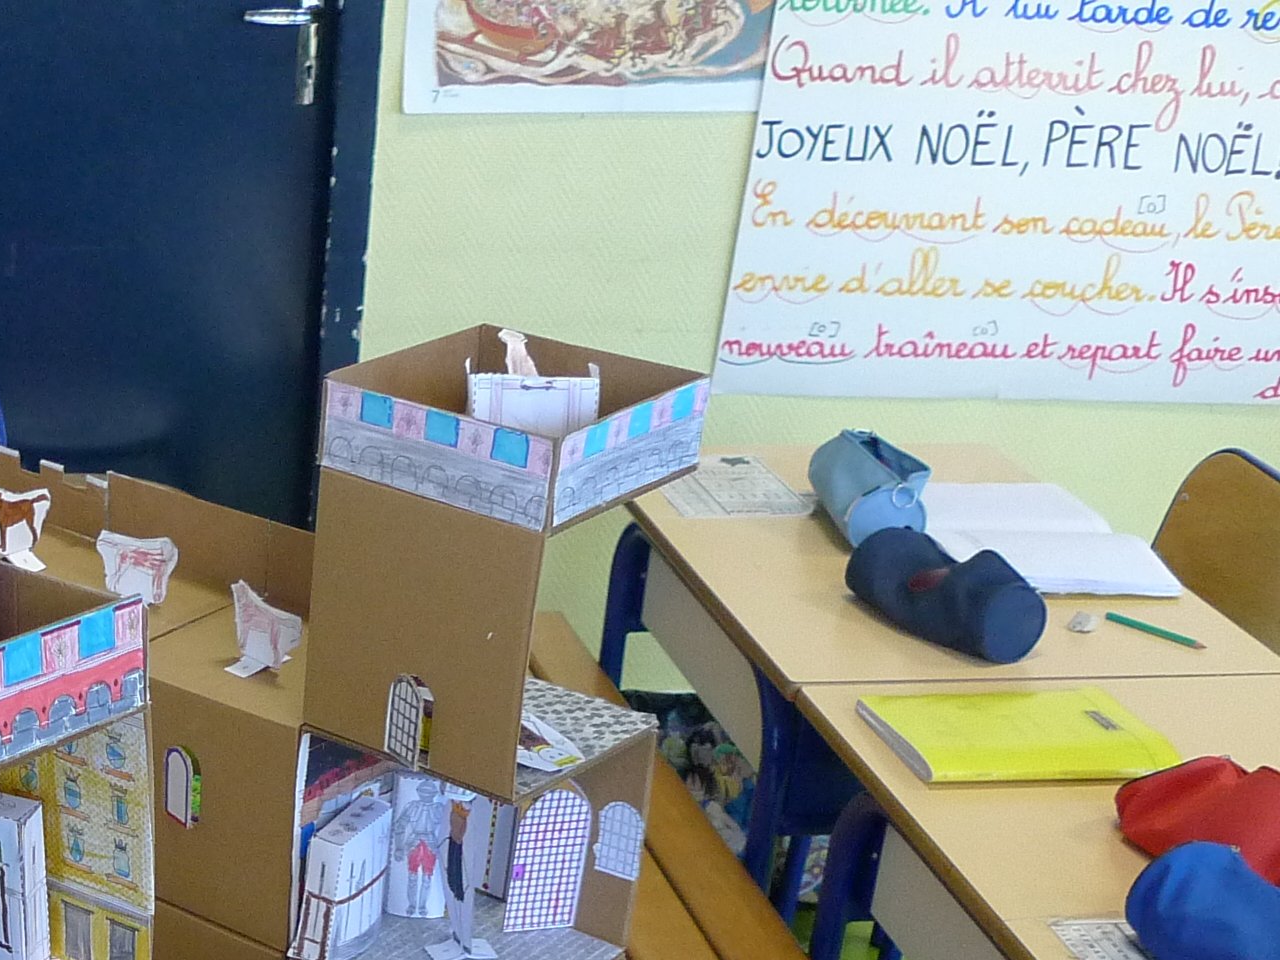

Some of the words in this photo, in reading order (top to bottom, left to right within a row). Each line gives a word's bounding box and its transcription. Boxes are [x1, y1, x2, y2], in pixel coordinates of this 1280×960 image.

[1181, 0, 1232, 28] de
[431, 89, 440, 103] 7
[771, 35, 914, 88] Quand
[920, 32, 964, 88] il
[967, 51, 1104, 93] atterrit
[1107, 40, 1184, 132] chez
[1189, 44, 1250, 107] lui,
[755, 120, 893, 162] JOYEUX
[915, 109, 1029, 177] NOËL,
[1042, 105, 1153, 170] PÈRE
[752, 178, 793, 228] En
[805, 190, 988, 231] découvrant
[992, 213, 1054, 235] son
[1183, 193, 1222, 239] le
[733, 266, 833, 293] envie
[838, 246, 966, 298] d'aller
[971, 279, 1017, 299] se
[1021, 253, 1156, 303] coucher.
[1160, 260, 1196, 303] Il
[721, 338, 855, 359] nouveau
[863, 322, 1017, 360] traîneau
[1020, 333, 1059, 360] et
[1057, 330, 1161, 381] repart
[1169, 322, 1244, 388] faire
